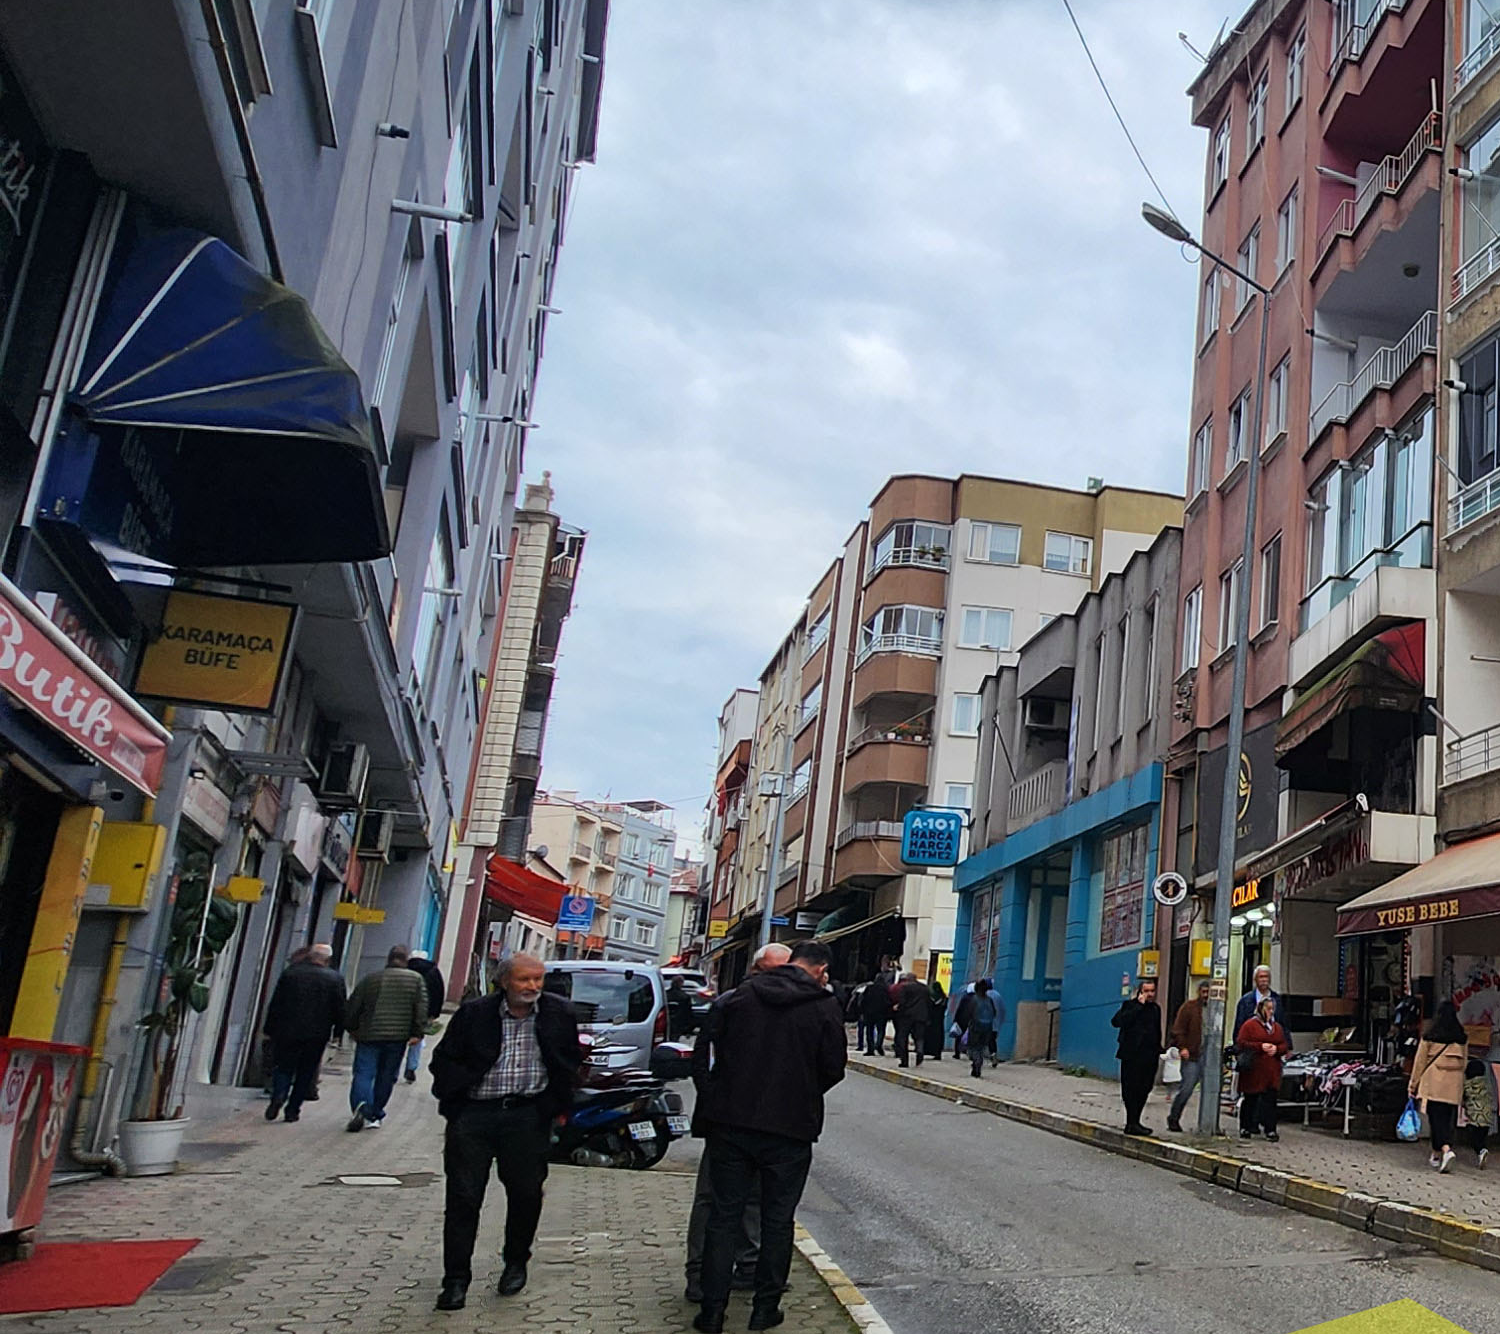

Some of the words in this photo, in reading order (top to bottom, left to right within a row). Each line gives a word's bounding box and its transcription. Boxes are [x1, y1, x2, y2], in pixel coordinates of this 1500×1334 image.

[161, 622, 274, 655] KARAMAÇA
[184, 646, 241, 670] BÜFE
[909, 840, 953, 851] HARCA
[910, 830, 953, 841] HARCA
[1376, 906, 1415, 926] YUSE
[1419, 899, 1459, 920] BEBE
